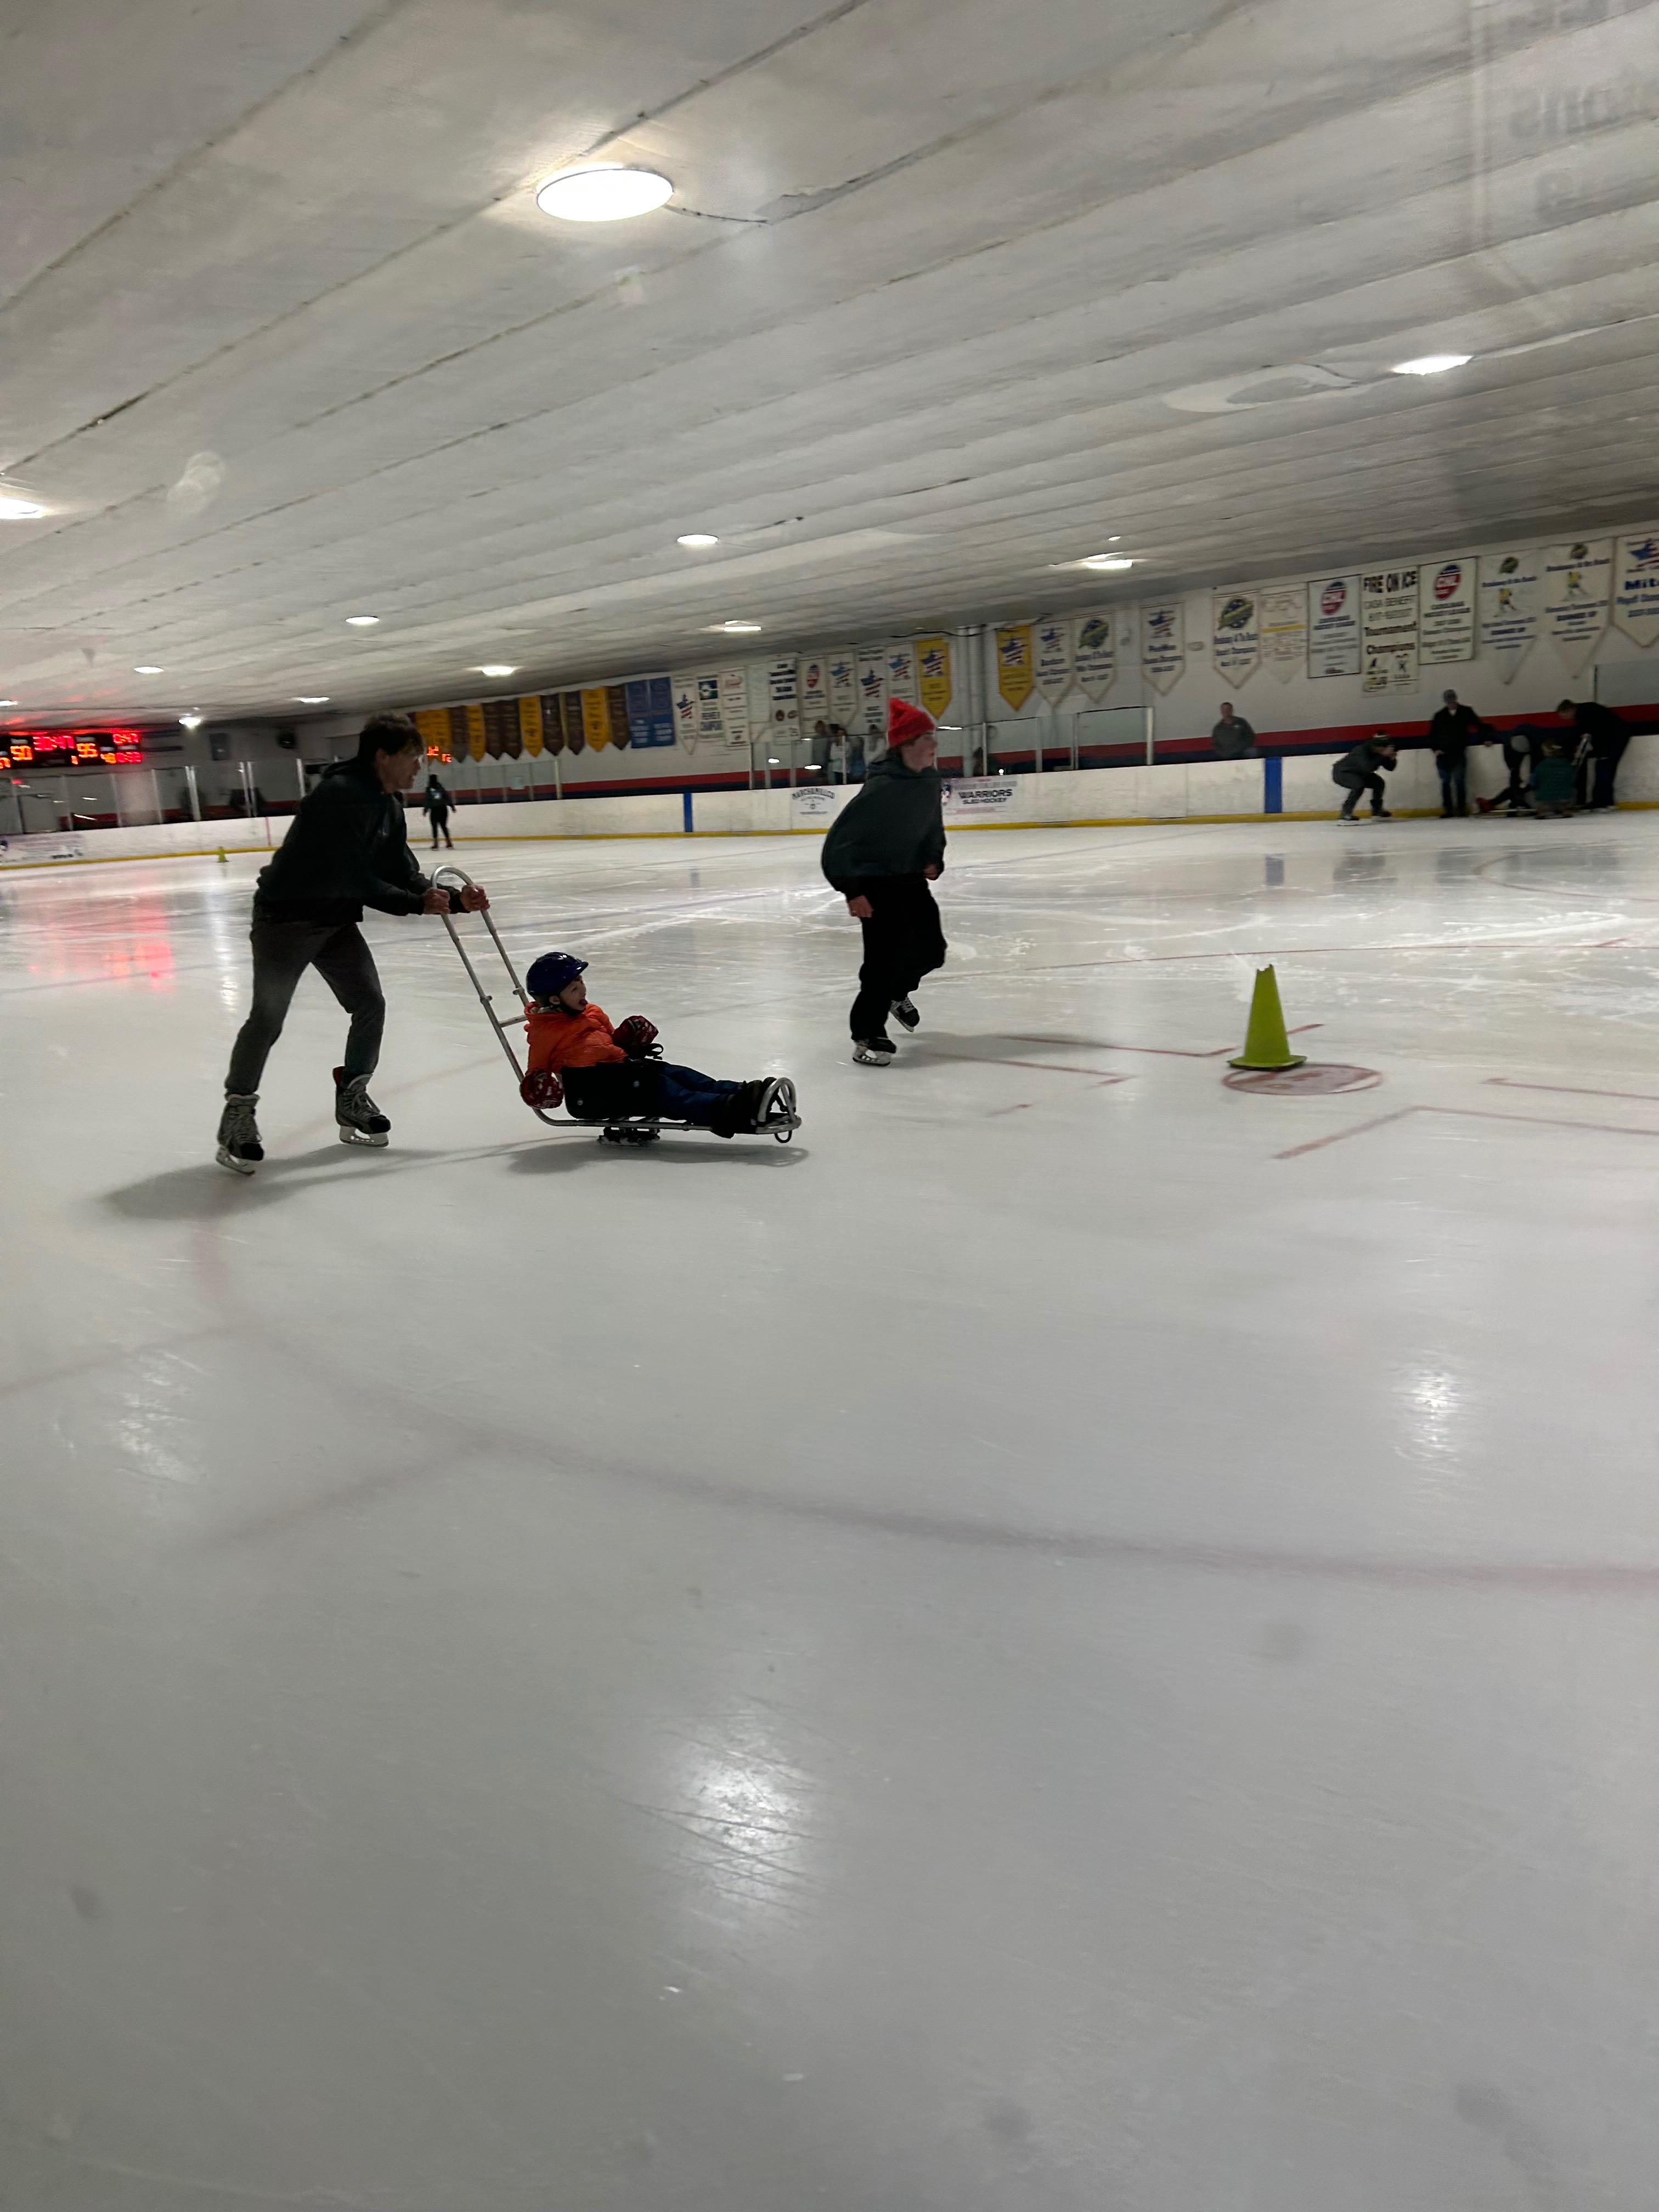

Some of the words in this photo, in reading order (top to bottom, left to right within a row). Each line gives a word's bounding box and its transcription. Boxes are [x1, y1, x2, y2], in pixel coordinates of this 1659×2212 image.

[1364, 575, 1383, 593] FIRE
[1386, 573, 1399, 592] ON
[1402, 571, 1416, 589] ICE
[958, 789, 1013, 798] WARRIORS
